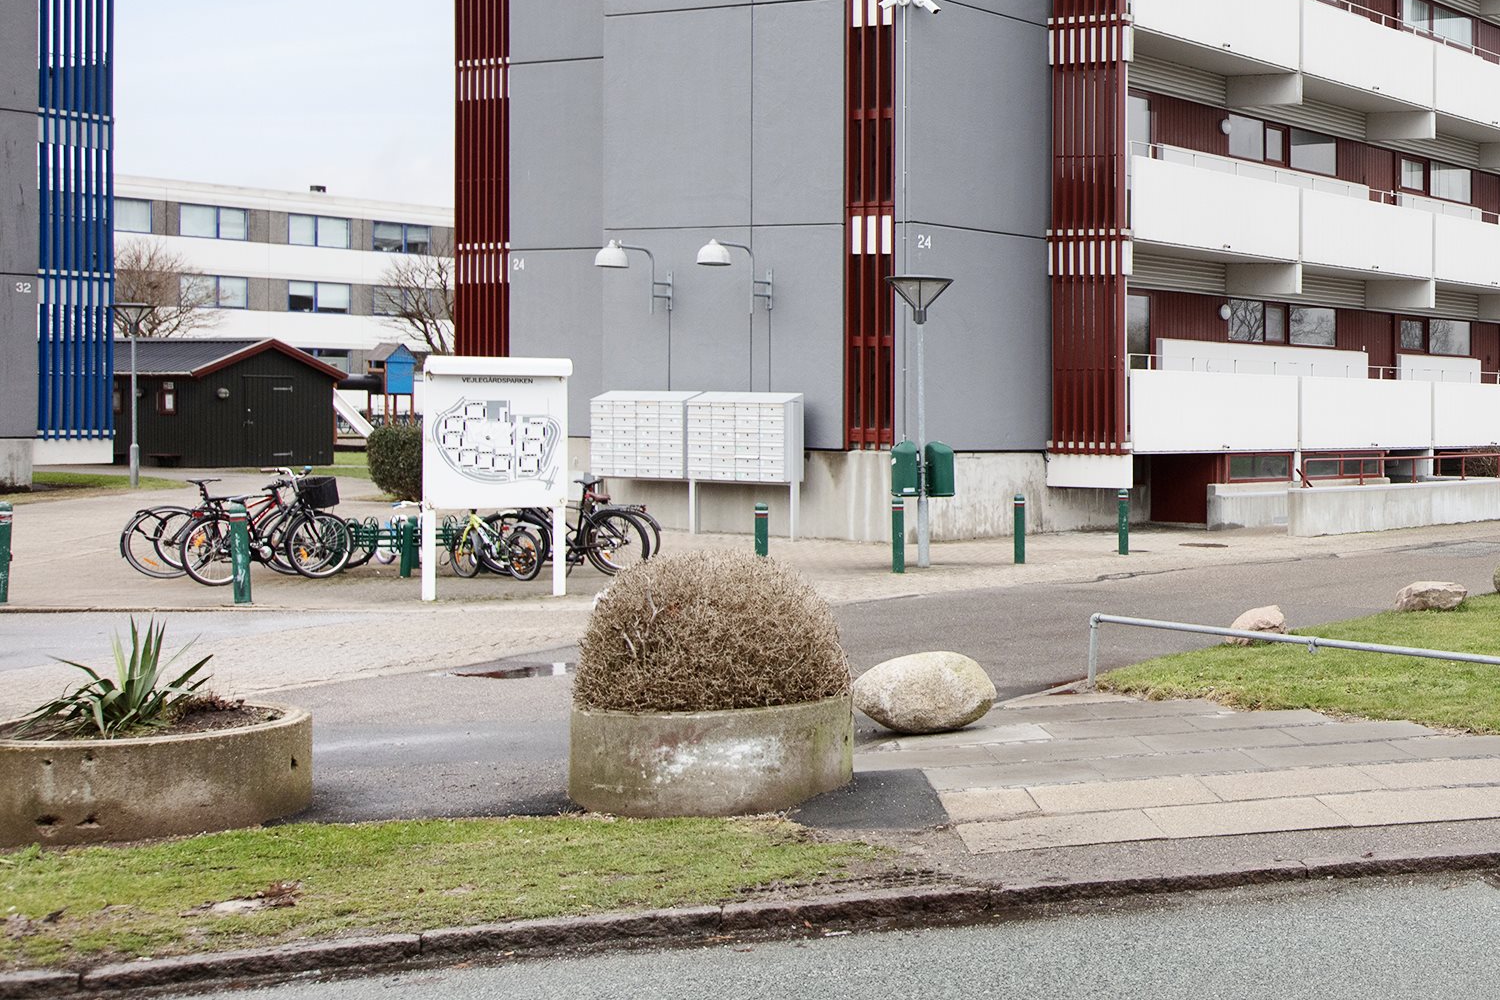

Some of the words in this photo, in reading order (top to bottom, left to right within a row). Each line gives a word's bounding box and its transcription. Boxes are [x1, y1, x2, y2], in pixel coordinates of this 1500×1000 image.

[917, 234, 931, 249] 24
[513, 258, 525, 270] 24
[15, 281, 32, 294] 32
[461, 376, 534, 384] VEJLEGÅRDSPARKEN
